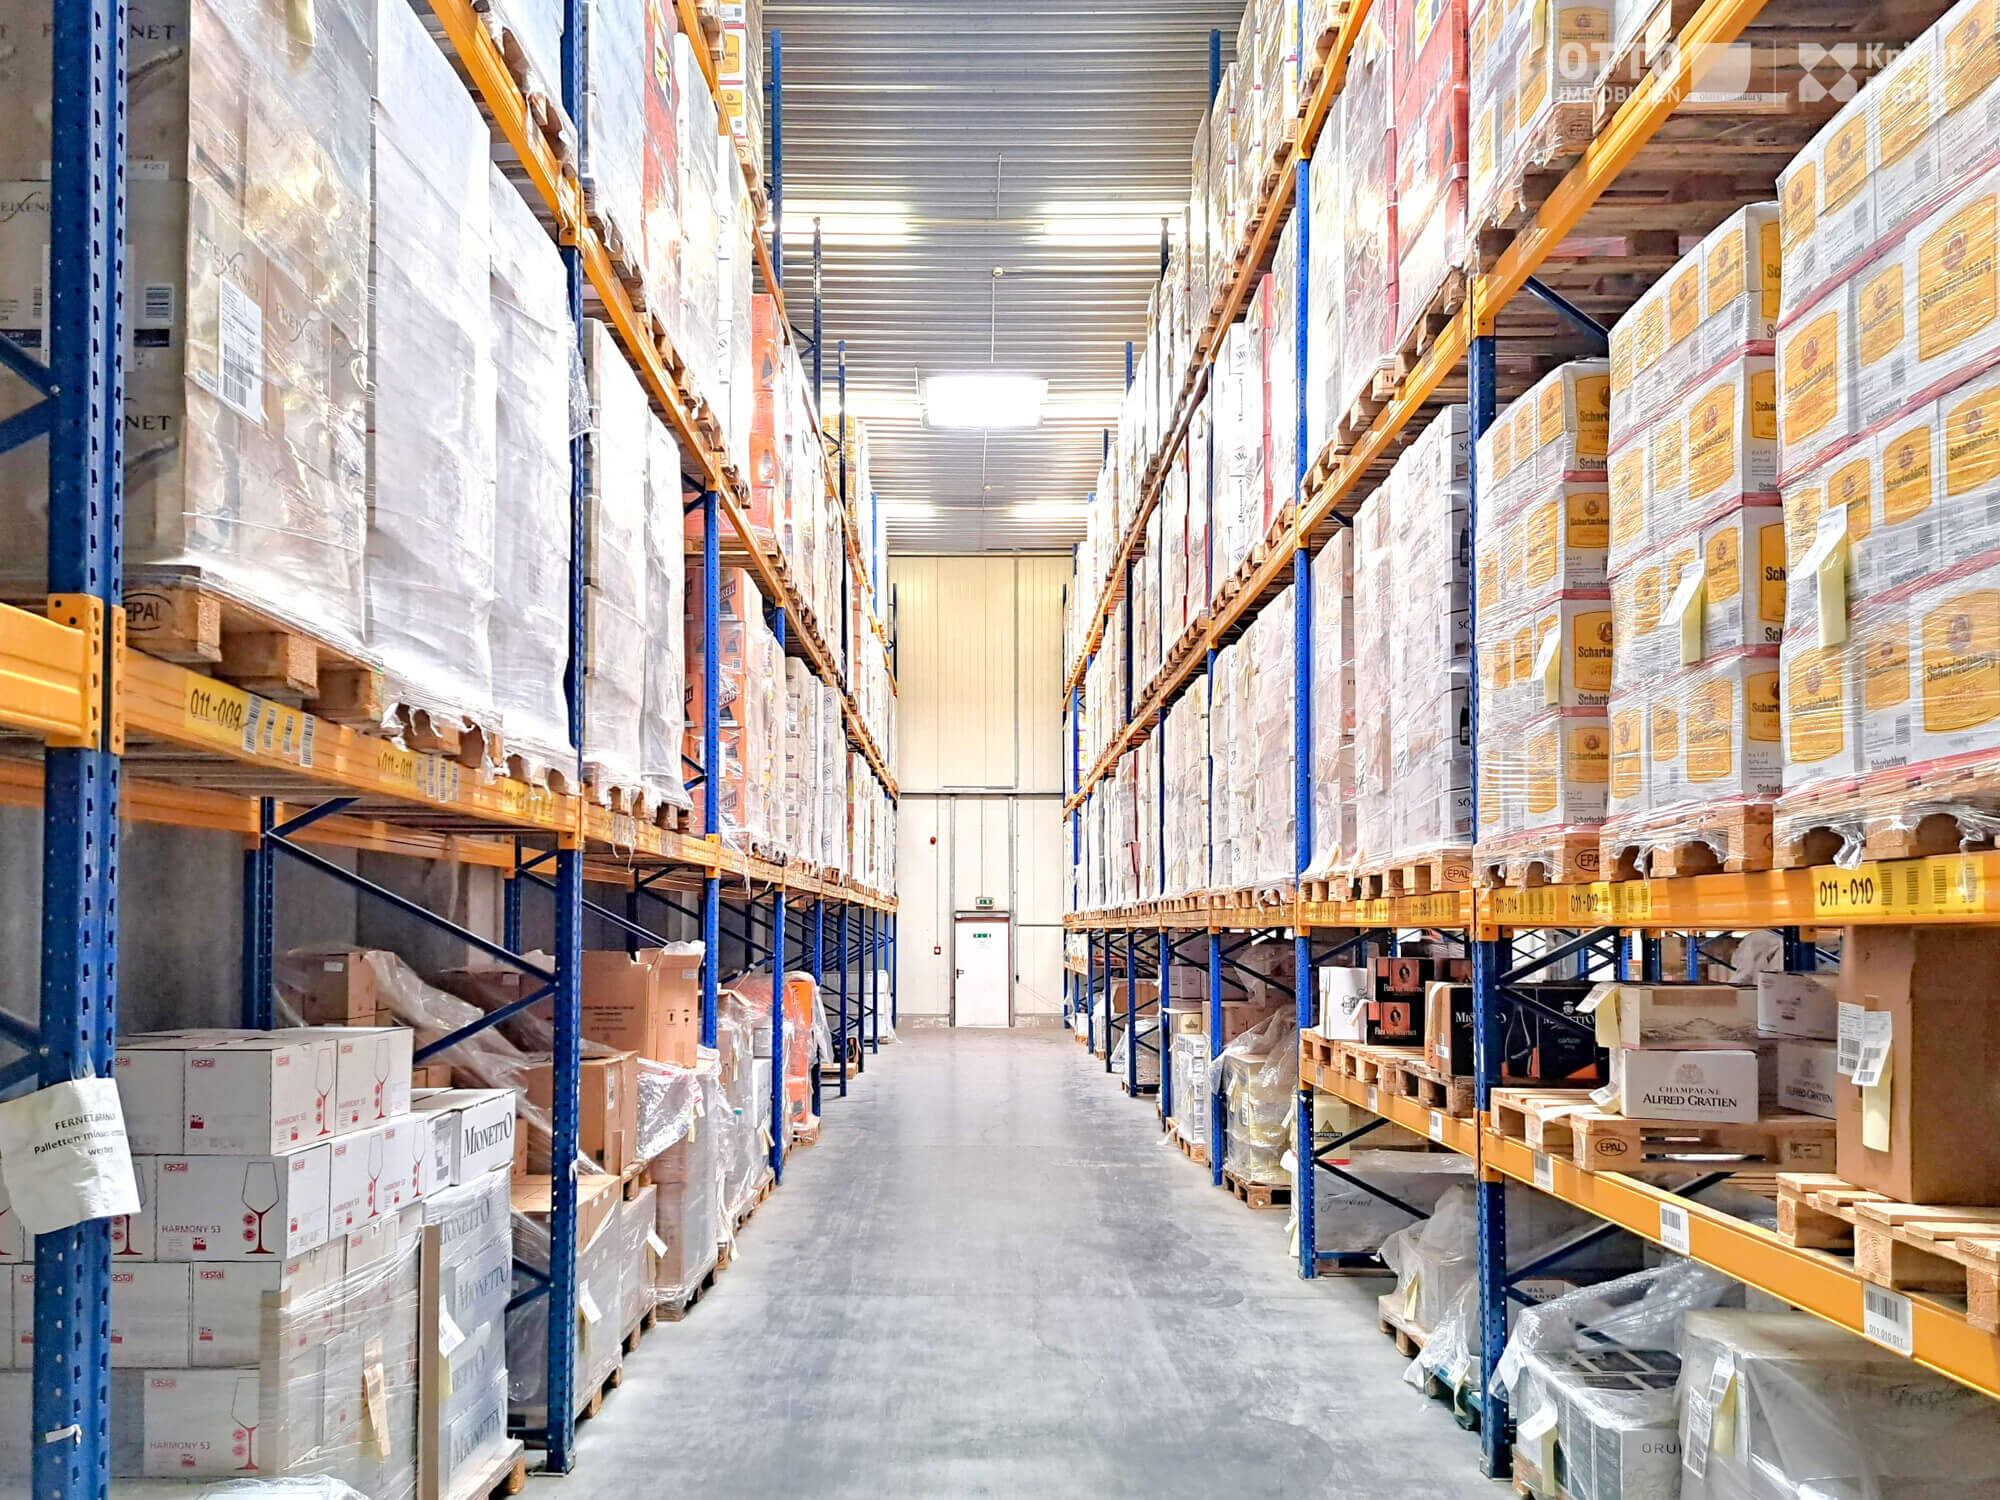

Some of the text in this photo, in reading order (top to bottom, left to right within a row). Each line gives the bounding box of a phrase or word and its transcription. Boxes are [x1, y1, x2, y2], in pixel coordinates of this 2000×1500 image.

[1659, 1086, 1720, 1096] CHAMPAGNE
[1642, 1093, 1737, 1108] ALFRED GRATIEN
[463, 1111, 512, 1159] MIONETTO
[1600, 1141, 1622, 1153] EPAL
[162, 1225, 207, 1233] HARMONY
[112, 1272, 133, 1282] astal
[150, 1441, 197, 1450] HARMONY
